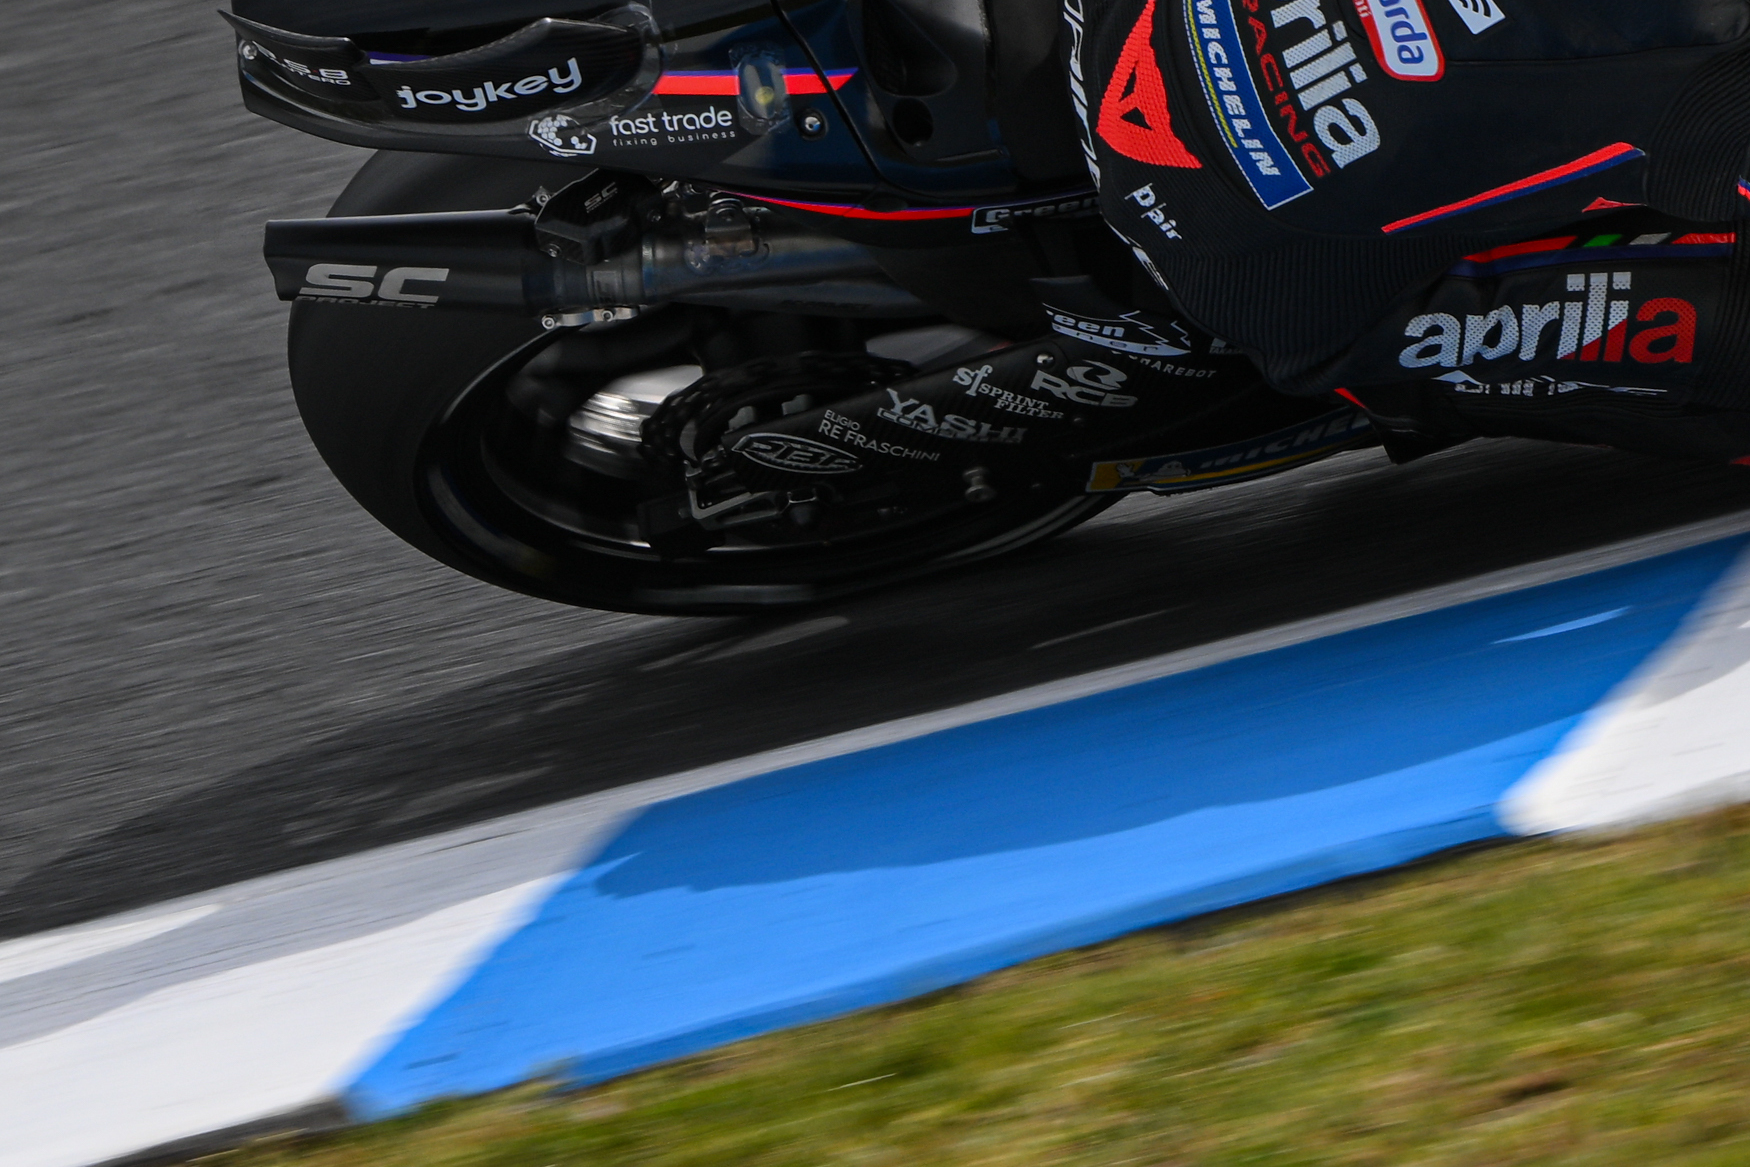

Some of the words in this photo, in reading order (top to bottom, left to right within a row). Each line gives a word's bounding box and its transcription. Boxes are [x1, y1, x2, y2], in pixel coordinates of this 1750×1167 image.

[396, 56, 583, 112] joykey
[609, 112, 660, 136] fast
[661, 105, 733, 133] trade
[611, 136, 659, 148] fixing
[667, 130, 737, 144] business
[300, 262, 450, 303] SC
[1400, 271, 1699, 369] aprilia
[978, 383, 1050, 411] SPRINT
[1031, 369, 1138, 408] RCB
[823, 409, 862, 432] ELIGIO
[994, 397, 1065, 420] FILTER
[818, 419, 843, 441] RE
[844, 429, 941, 463] FRASCHINI
